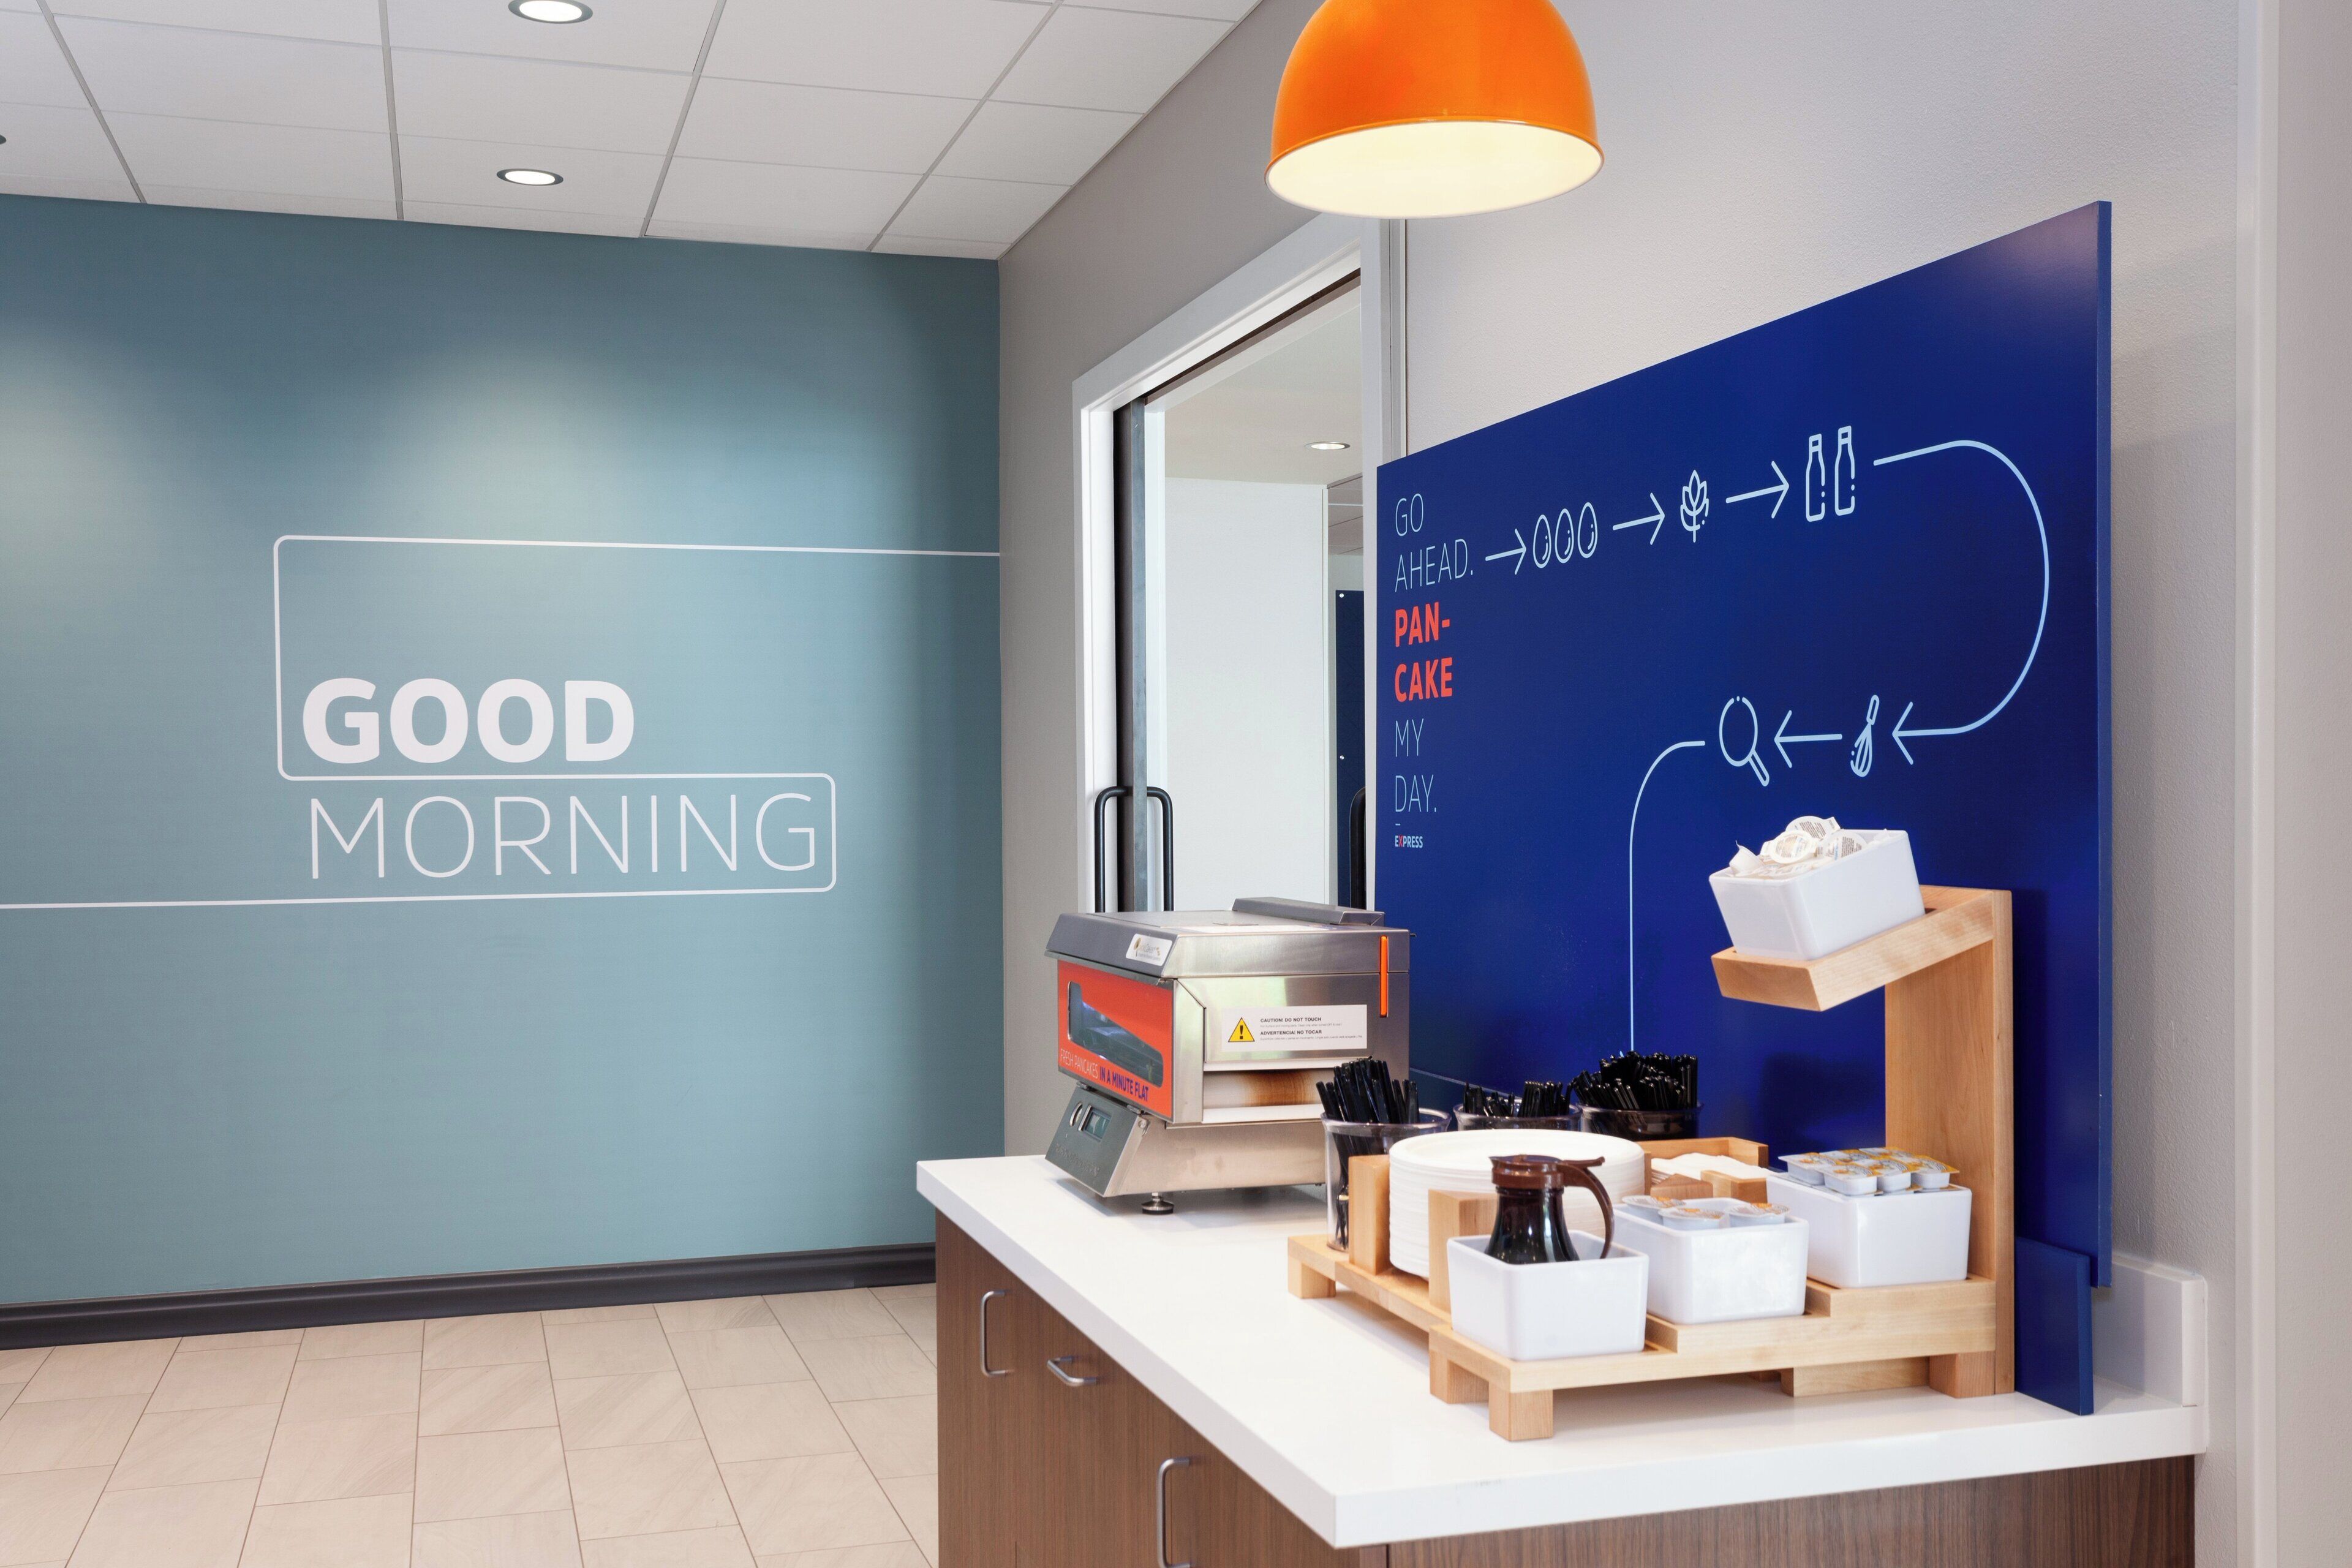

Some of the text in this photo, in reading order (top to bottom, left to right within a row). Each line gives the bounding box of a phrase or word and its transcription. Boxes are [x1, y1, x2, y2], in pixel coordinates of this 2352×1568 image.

[1396, 494, 1423, 536] GO
[1395, 539, 1472, 592] AHEAD.
[1395, 602, 1450, 647] PAN-
[1395, 657, 1452, 702] CAKE
[303, 677, 634, 763] GOOD
[1396, 718, 1423, 756] MY
[1396, 775, 1436, 812] DAY.
[312, 793, 814, 878] MORNING
[1395, 835, 1423, 848] EXPRESS
[1060, 1048, 1149, 1102] FRESH PANCAKES IN A MINUTE FLAT
